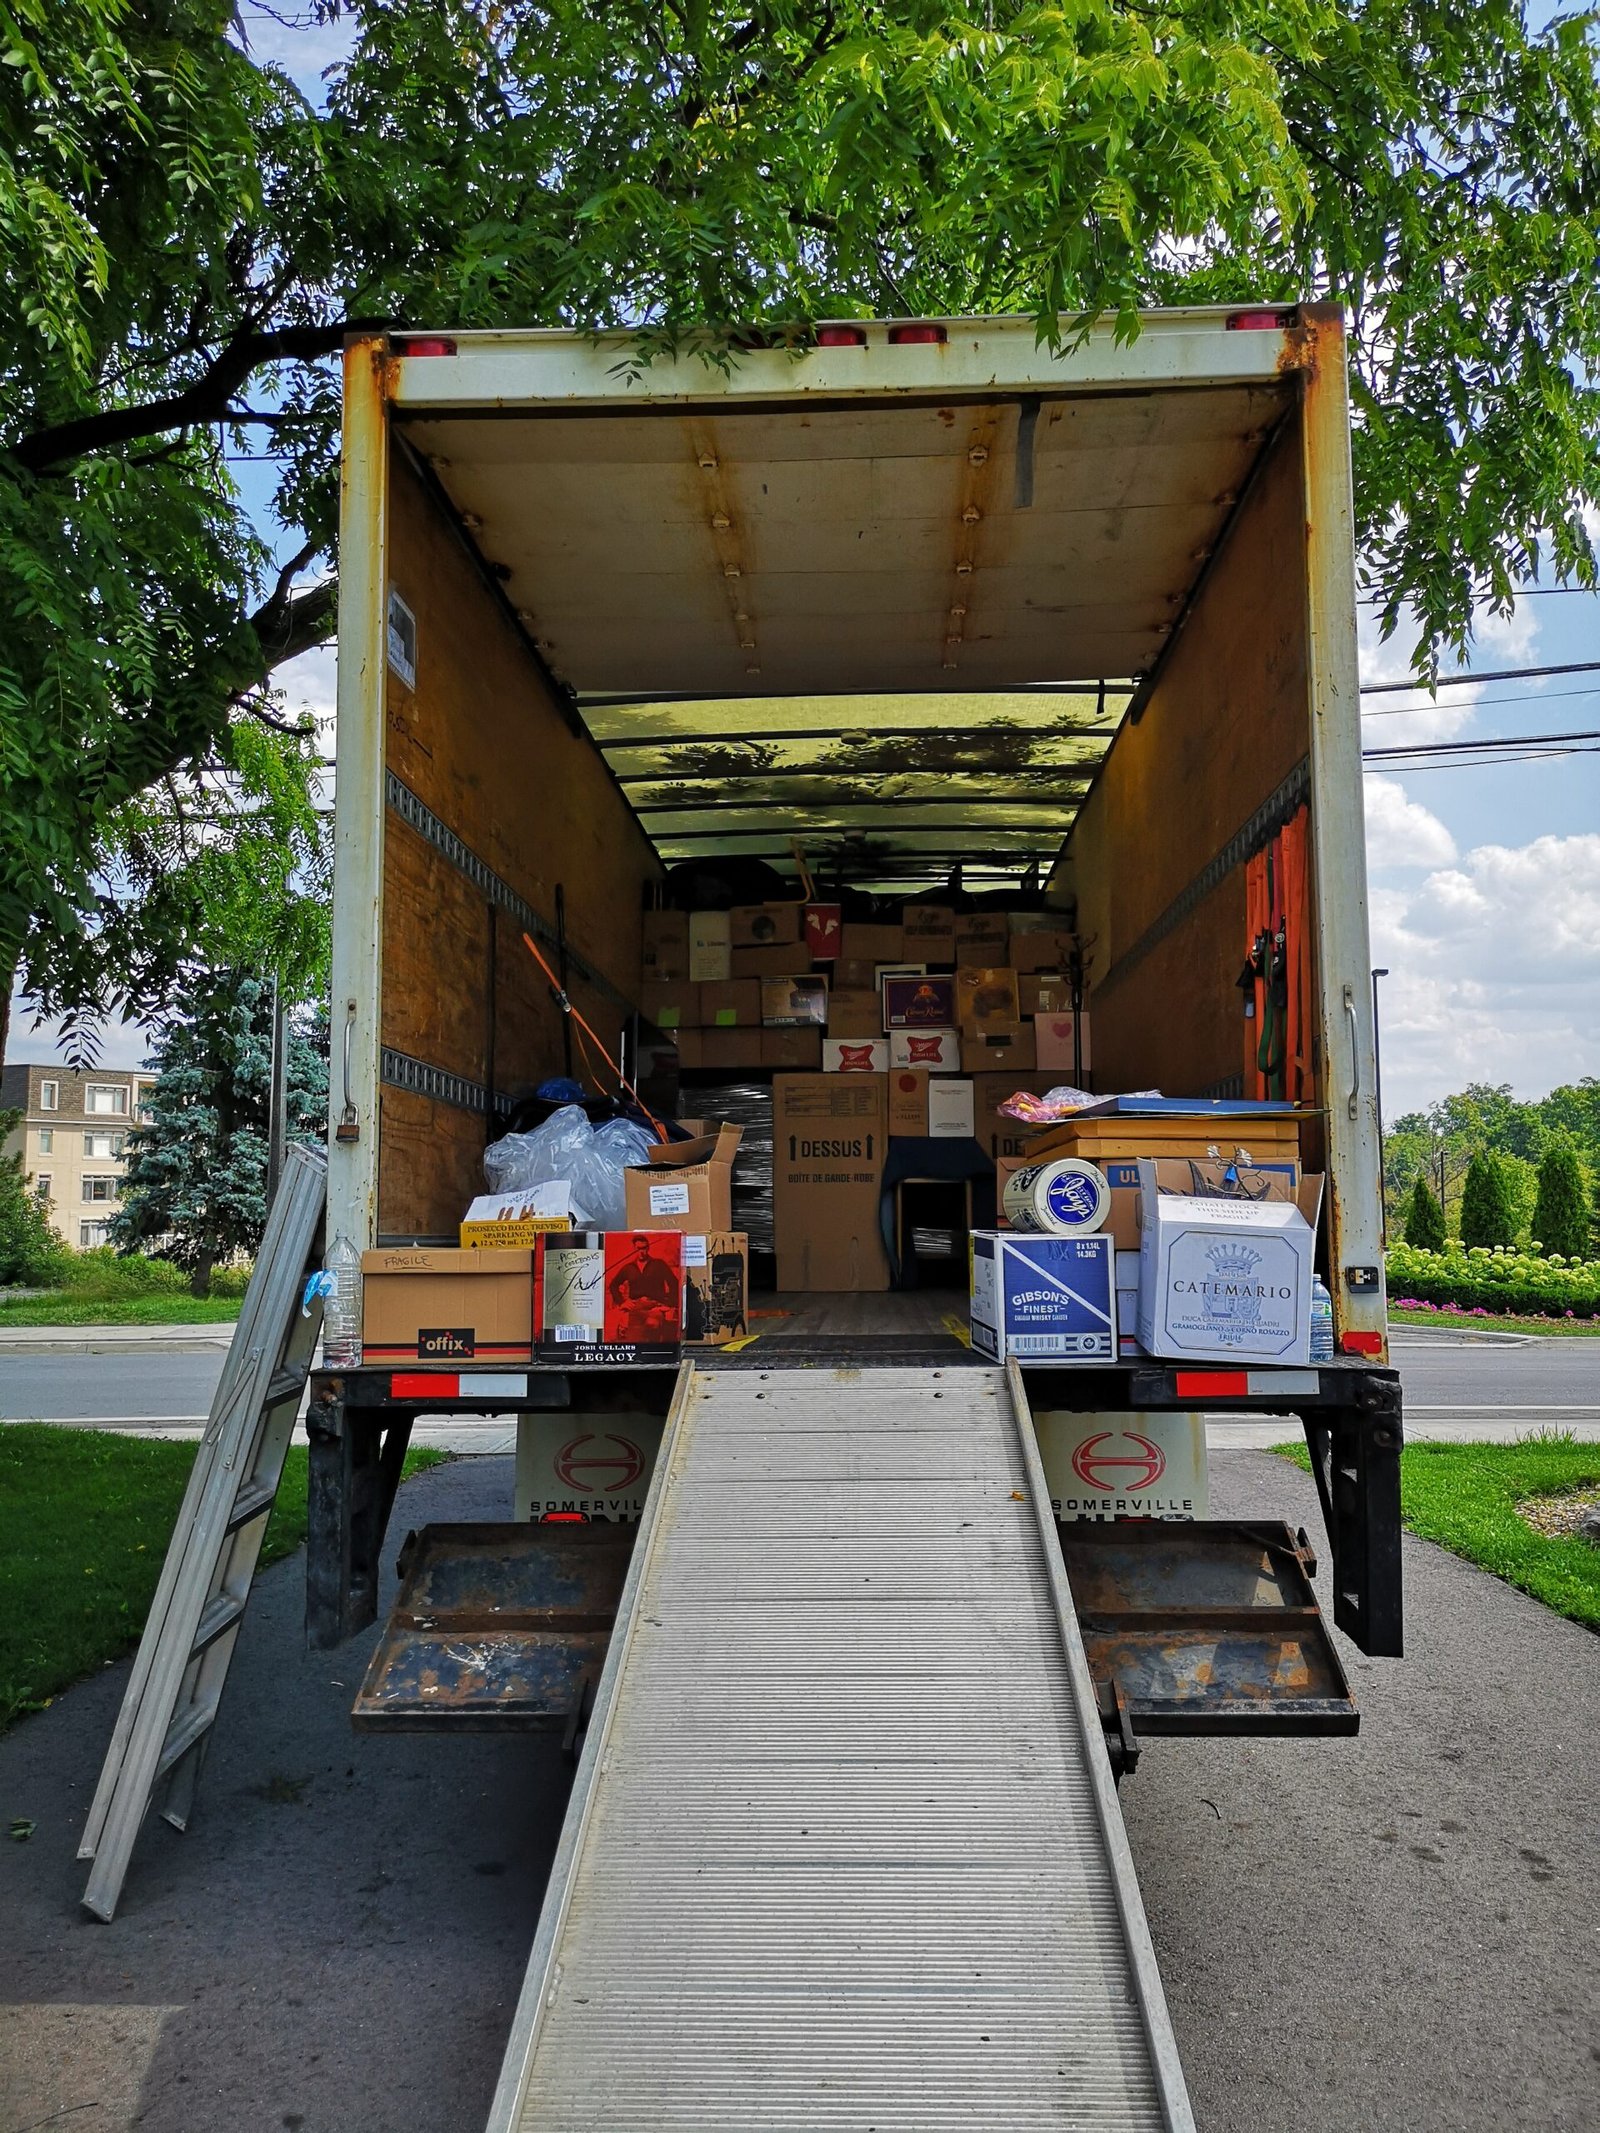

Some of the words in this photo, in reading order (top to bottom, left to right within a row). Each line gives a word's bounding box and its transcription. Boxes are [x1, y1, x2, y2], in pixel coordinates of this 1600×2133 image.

[801, 1140, 862, 1158] DESSUS
[1003, 1139, 1024, 1156] DE
[812, 1173, 824, 1183] DE
[1120, 1170, 1139, 1183] UL
[1050, 1177, 1090, 1218] Jays
[467, 1223, 507, 1233] PROSECCO
[508, 1222, 530, 1232] D.O.C.
[531, 1222, 563, 1231] TREVISO
[483, 1231, 525, 1239] SPARKLING
[527, 1230, 535, 1238] W
[520, 1238, 534, 1246] 17.0
[384, 1254, 433, 1268] FRAGILE
[1173, 1280, 1291, 1299] CATEMARIO
[1012, 1290, 1070, 1306] GIBSON'S
[1023, 1305, 1059, 1313] FINEST
[1172, 1322, 1224, 1332] GRAMOGLIANO
[1259, 1328, 1290, 1336] ROSAZZO
[426, 1336, 464, 1351] offix
[574, 1353, 636, 1362] LEGACY
[530, 1500, 643, 1512] SOMERVIL
[1051, 1499, 1193, 1510] SOMERVILLE
